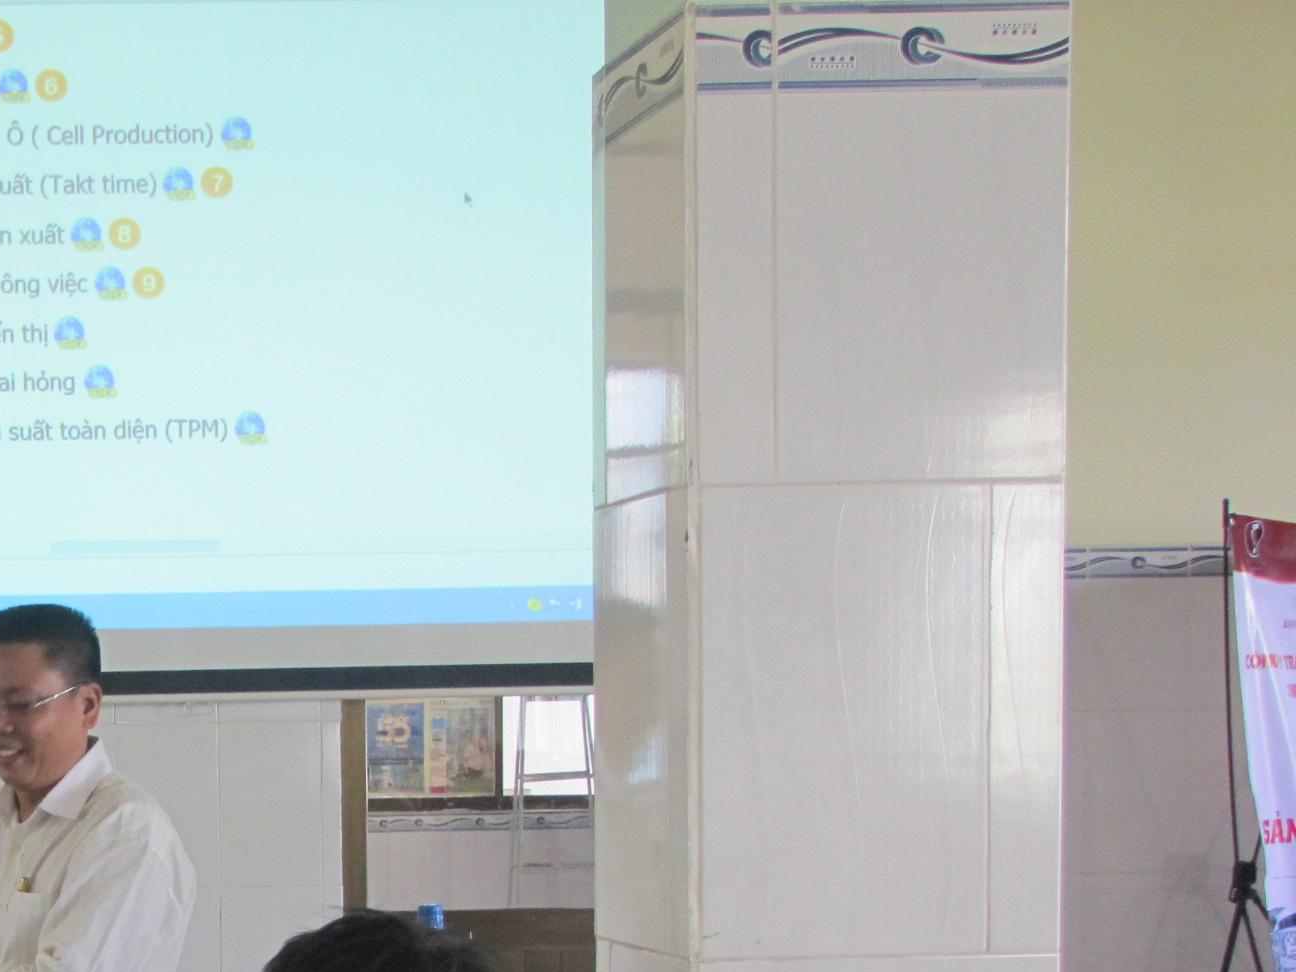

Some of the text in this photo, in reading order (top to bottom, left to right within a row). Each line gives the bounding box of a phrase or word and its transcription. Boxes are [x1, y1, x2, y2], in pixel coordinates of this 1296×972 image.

[7, 120, 23, 146] Ô
[47, 124, 85, 145] Cell
[92, 122, 214, 149] Production)
[40, 173, 96, 198] (Takt
[101, 172, 157, 196] time)
[18, 223, 65, 246] xuất
[47, 272, 88, 298] việc
[21, 323, 49, 348] thị
[22, 369, 76, 396] hỏng
[8, 417, 54, 442] suất
[60, 417, 106, 440] toàn
[113, 416, 158, 443] diện
[164, 416, 229, 443] (TPM)
